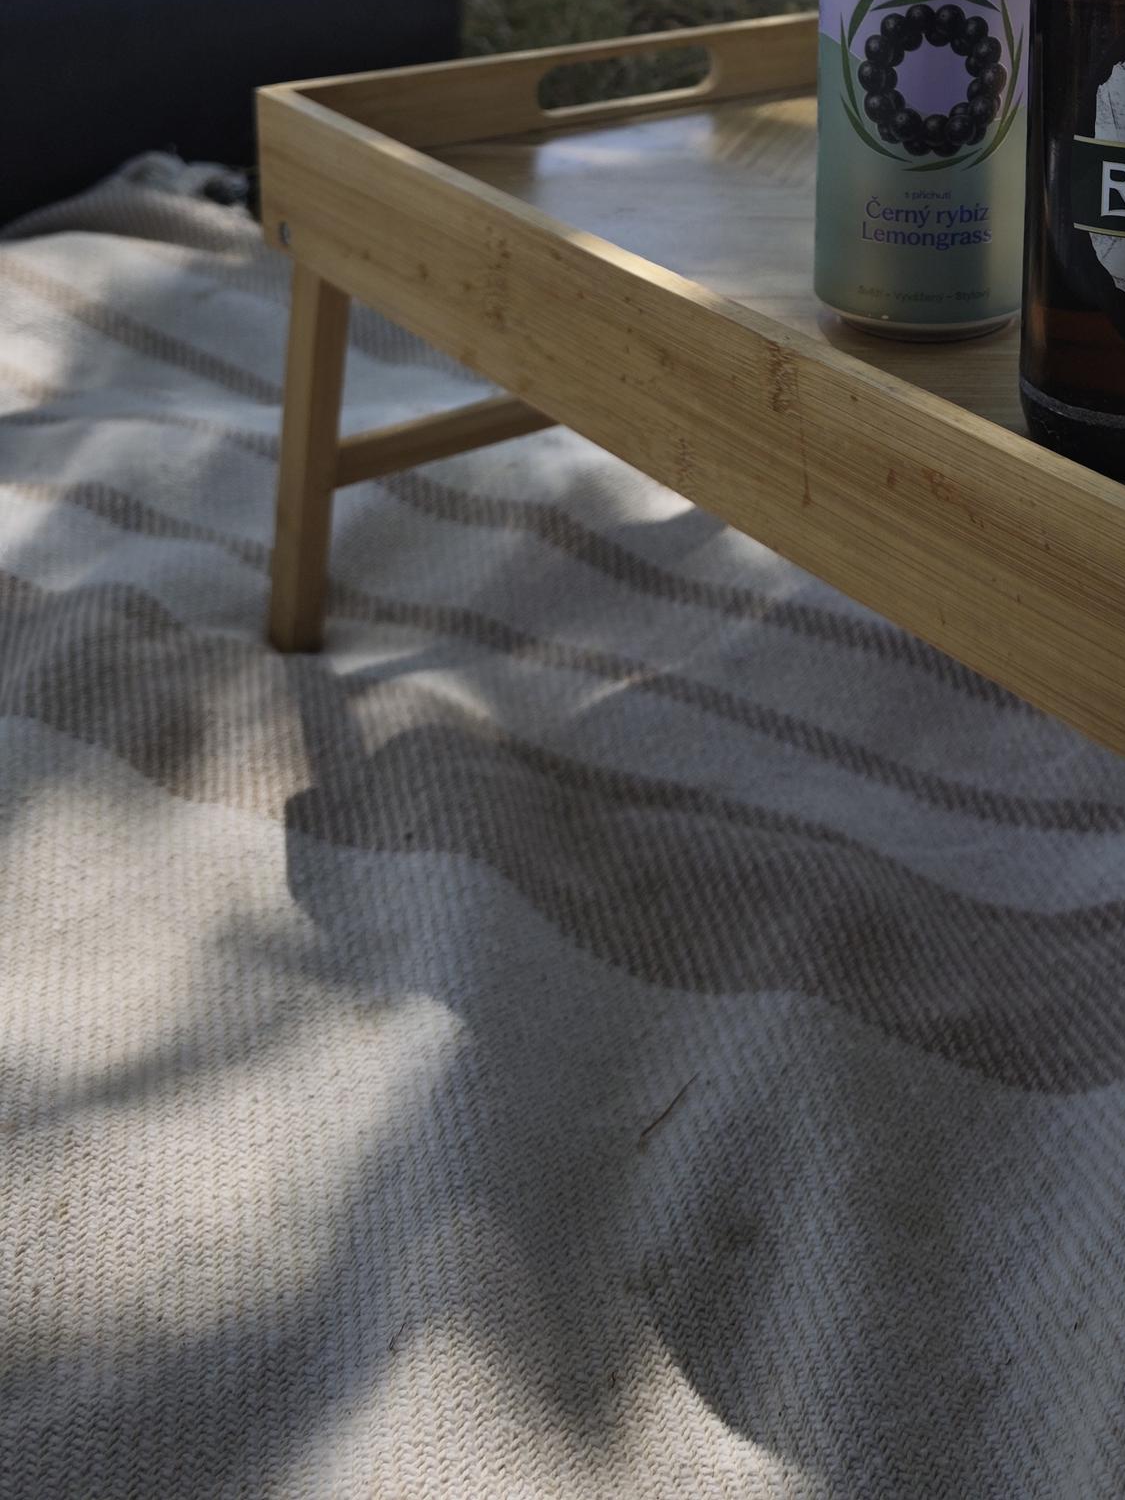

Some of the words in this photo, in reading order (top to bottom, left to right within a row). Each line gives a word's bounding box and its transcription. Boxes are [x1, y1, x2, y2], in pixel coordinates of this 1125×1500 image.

[865, 196, 930, 228] Černý
[935, 202, 990, 228] rybíz
[862, 221, 992, 250] Lemongrass
